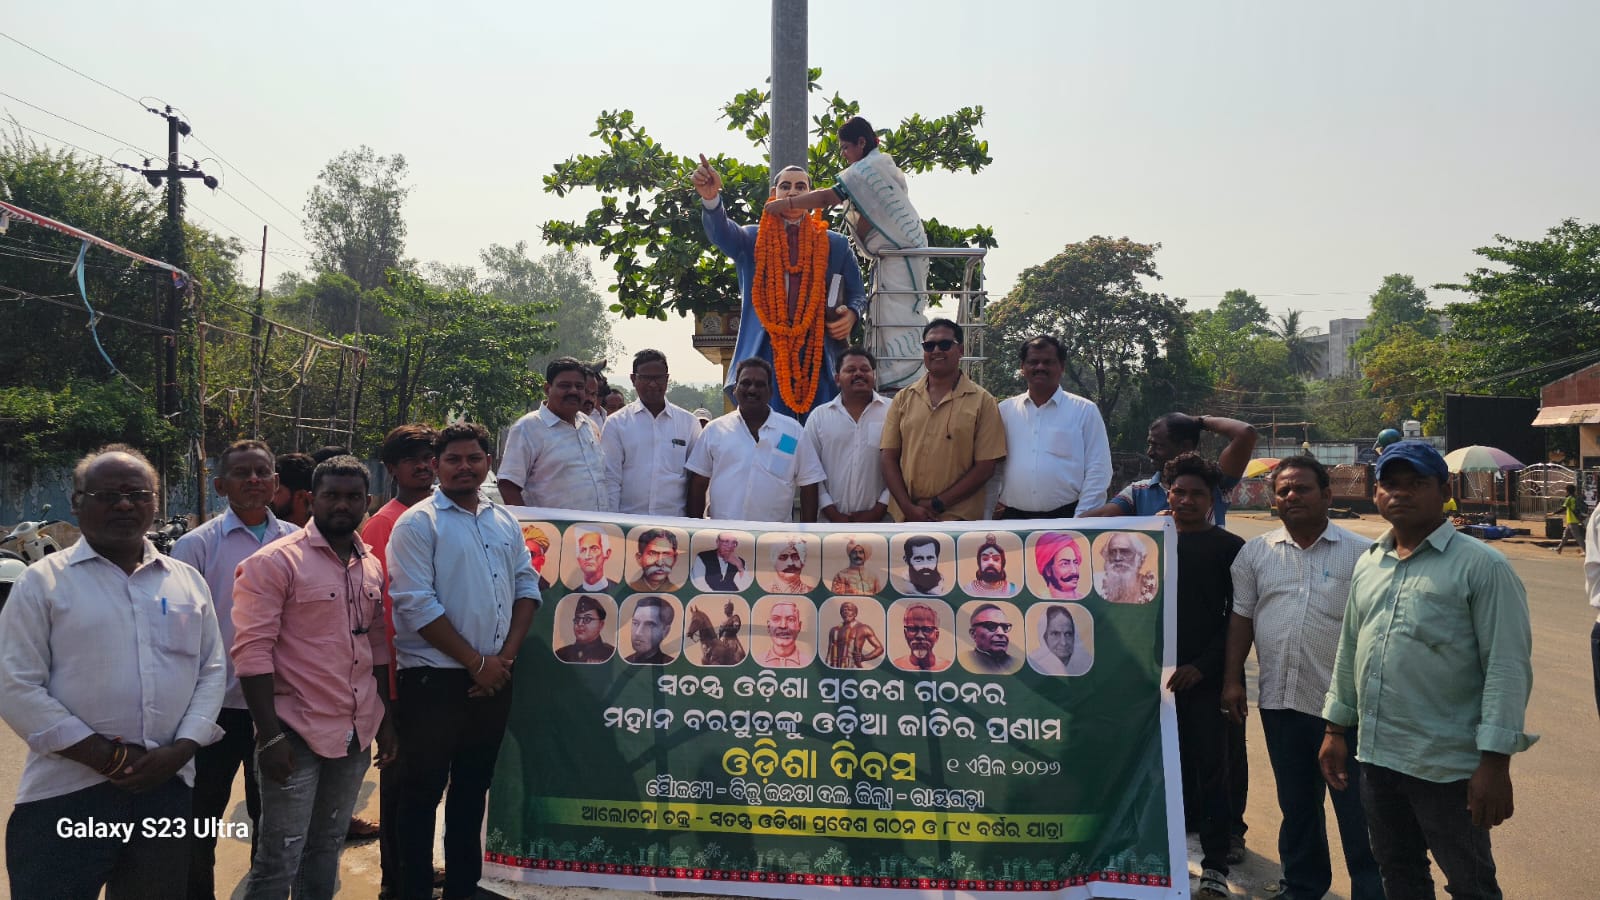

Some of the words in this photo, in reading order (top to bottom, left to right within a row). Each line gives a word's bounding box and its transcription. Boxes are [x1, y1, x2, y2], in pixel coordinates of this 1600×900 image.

[733, 669, 808, 703] ଓଡ଼ିଶା
[818, 677, 905, 703] ପ୍ରଦେଶ
[914, 680, 1007, 706] ଗଠନର
[603, 706, 674, 735] ମହାନ
[683, 709, 804, 739] ବରପୁତ୍ରଙ୍କୁ
[812, 705, 887, 740] ଓଡ଼ିଆ
[897, 708, 977, 740] ଜାତିର
[986, 717, 1062, 743] ପ୍ରଣାମ
[721, 737, 817, 784] ଓଡ଼ିଶା
[830, 739, 916, 781] ଦିବସ
[946, 758, 960, 773] ୧
[965, 754, 1007, 777] ଏପ୍ରିଲ
[1011, 760, 1061, 776] ୨୦୨୬
[646, 774, 713, 799] ସୌଜନ୍ୟ
[729, 777, 761, 805] ବିଜୁ
[764, 783, 813, 802] ଜନତା
[855, 781, 893, 810] ଜିଲ୍ଲା
[581, 806, 657, 825] ଆଲୋଚନା
[813, 815, 868, 834] ପ୍ରଦେଶ
[873, 817, 916, 834] ଗଠନ
[922, 819, 937, 835] ଓ
[942, 821, 971, 836] ୮୯
[976, 816, 1021, 838] ବର୍ଷର
